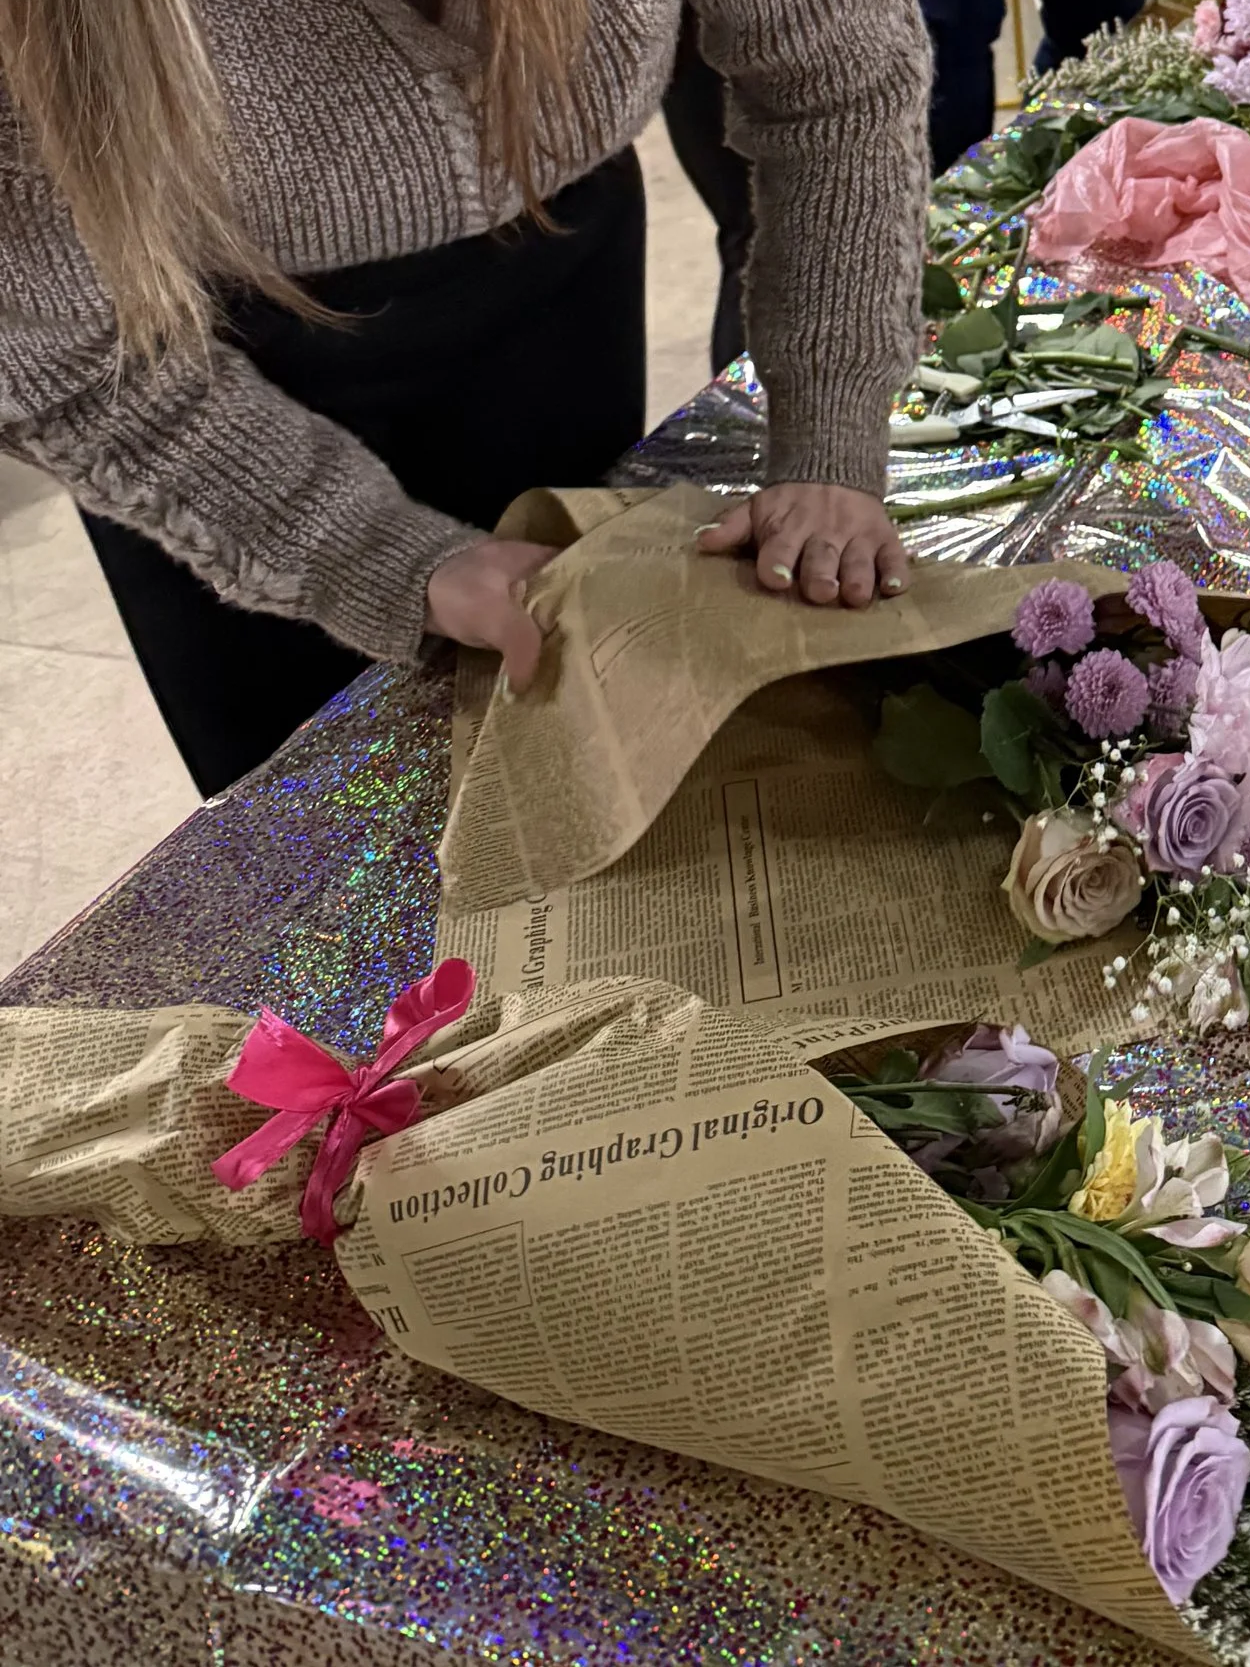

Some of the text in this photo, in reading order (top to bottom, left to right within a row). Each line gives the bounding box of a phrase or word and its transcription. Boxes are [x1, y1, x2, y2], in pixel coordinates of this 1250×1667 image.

[522, 902, 553, 975] Graphing
[692, 1095, 826, 1152] Original
[538, 1126, 684, 1183] Graphing
[389, 1165, 533, 1224] Collection
